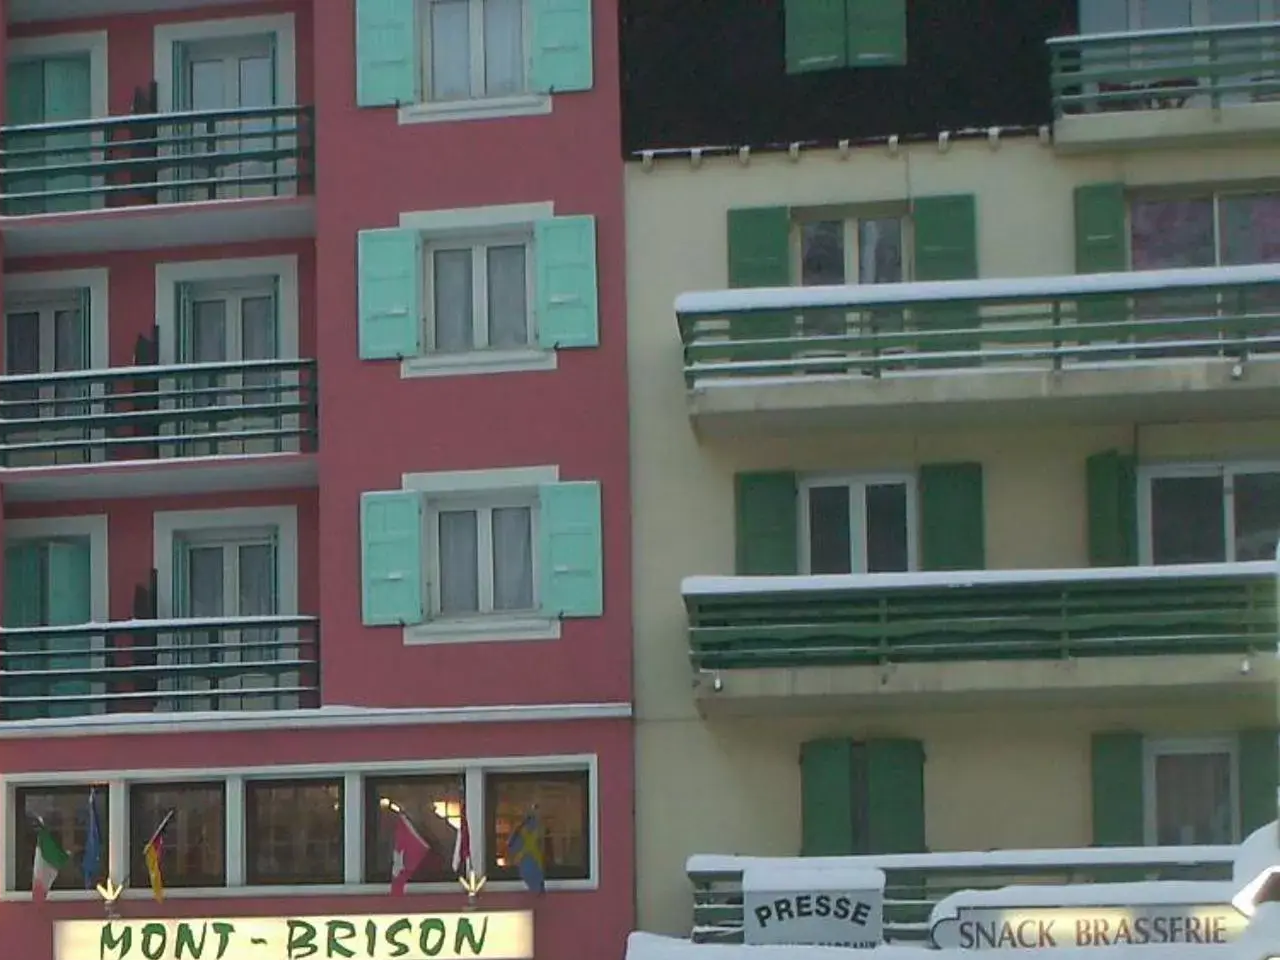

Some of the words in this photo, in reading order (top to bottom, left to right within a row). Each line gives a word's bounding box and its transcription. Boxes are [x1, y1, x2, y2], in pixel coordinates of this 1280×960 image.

[754, 895, 871, 928] PRESSE
[959, 919, 1056, 949] SNACK
[1075, 916, 1227, 946] BRASSERIE
